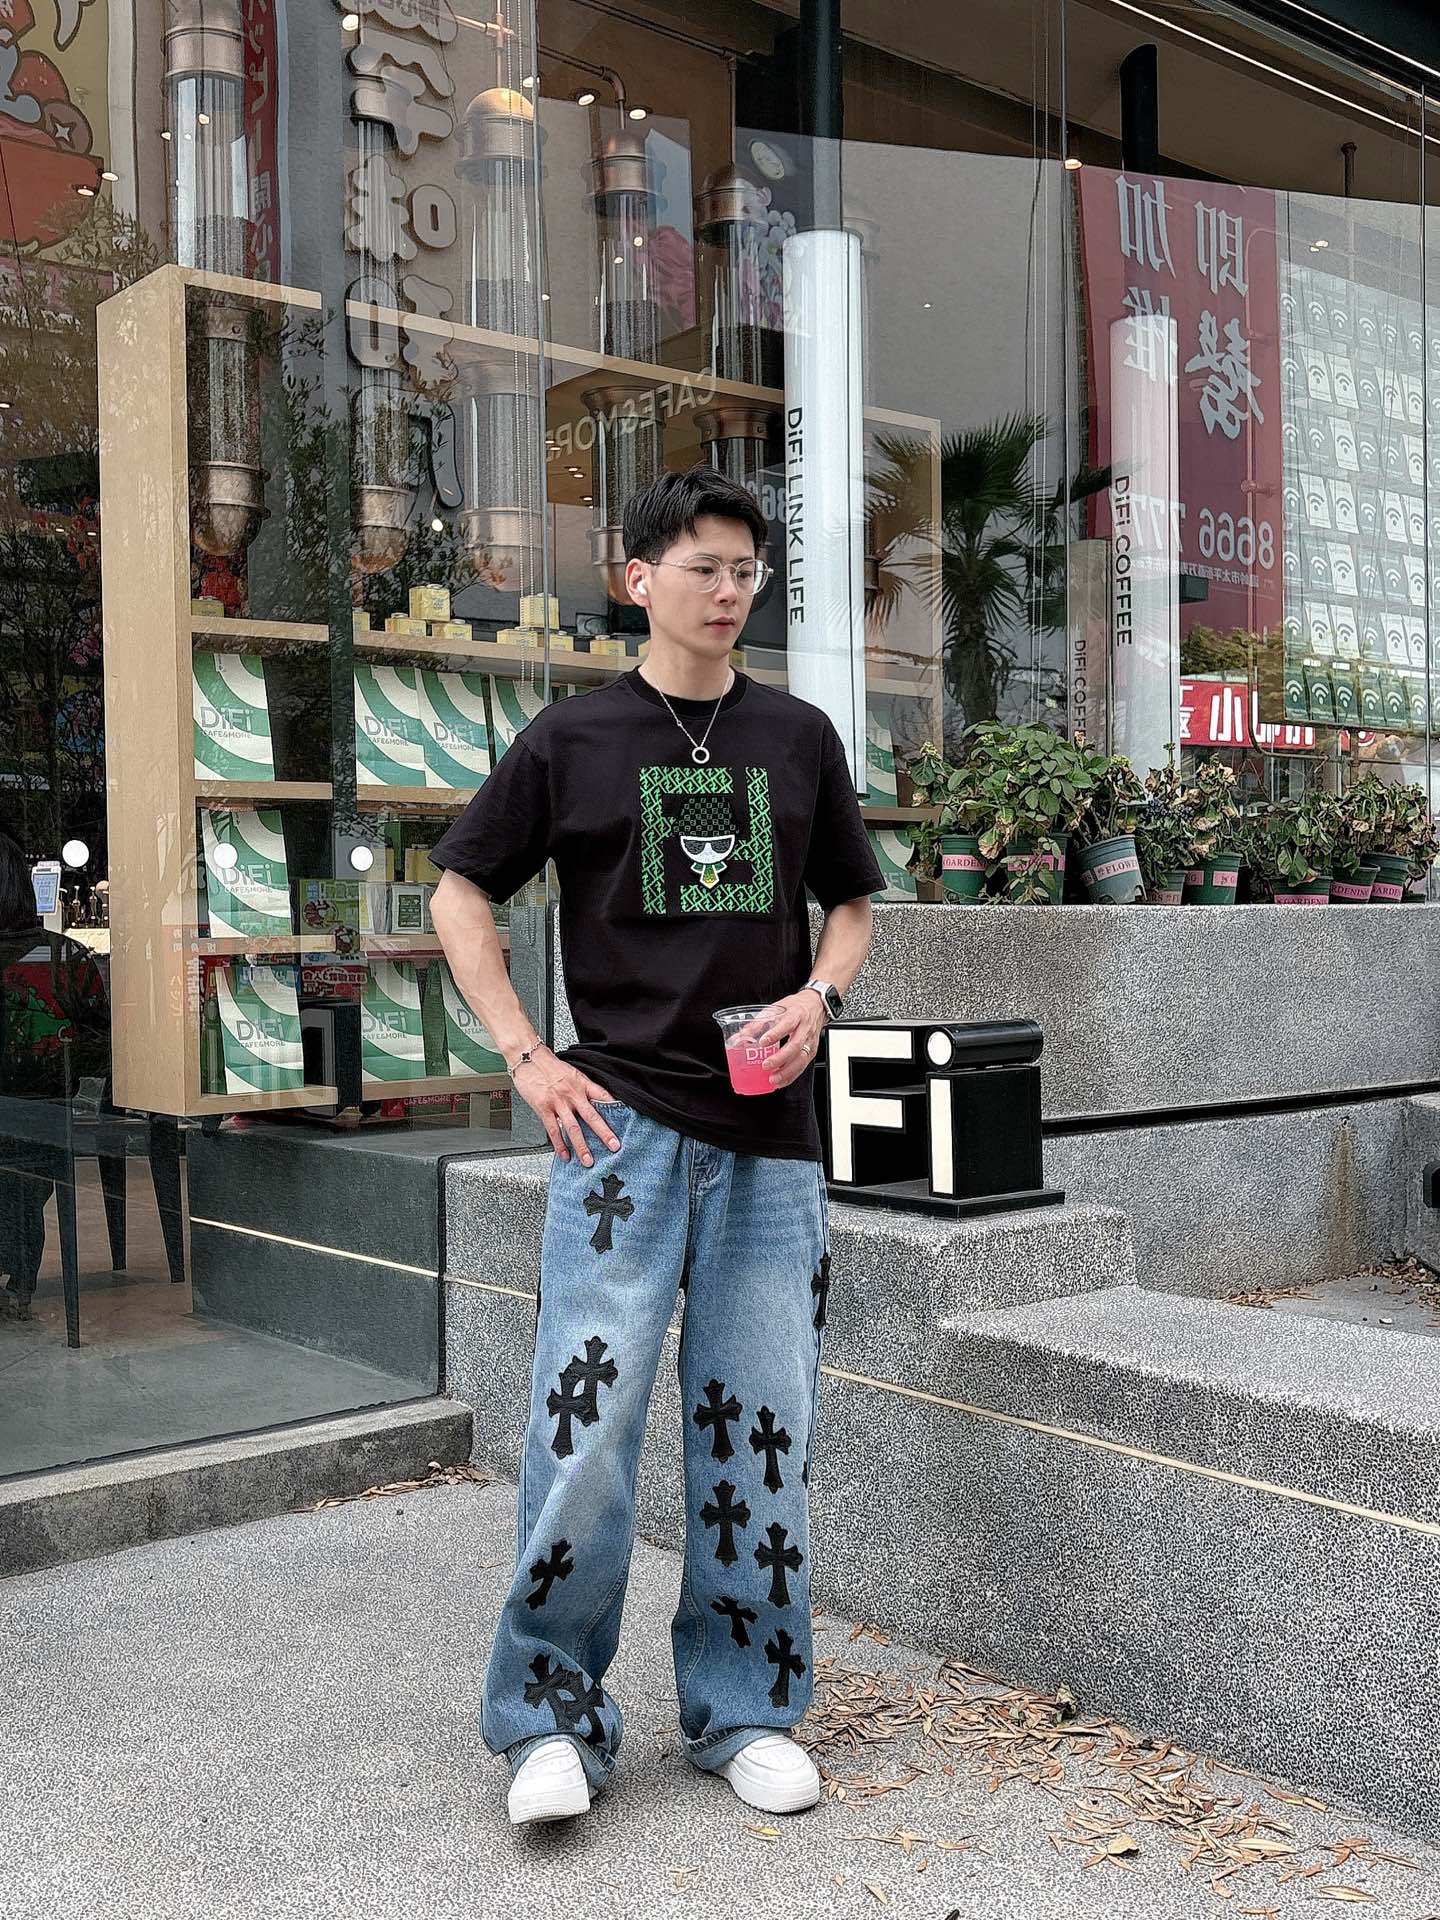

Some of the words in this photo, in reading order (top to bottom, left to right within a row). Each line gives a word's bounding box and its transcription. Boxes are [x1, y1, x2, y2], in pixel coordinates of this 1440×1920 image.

[788, 408, 803, 465] DiFi
[788, 474, 804, 549] LINK
[1115, 475, 1130, 526] DiFi
[789, 558, 805, 626] LIFE
[1115, 534, 1132, 647] COFFEE
[1074, 640, 1087, 672] DiFi
[200, 706, 252, 733] DiFi
[365, 716, 408, 738] DiFi
[1074, 677, 1087, 734] COFF
[222, 864, 273, 886] DiFi
[236, 1018, 284, 1041] DiFi
[362, 1010, 407, 1033] DiFi
[828, 1029, 954, 1195] Fi
